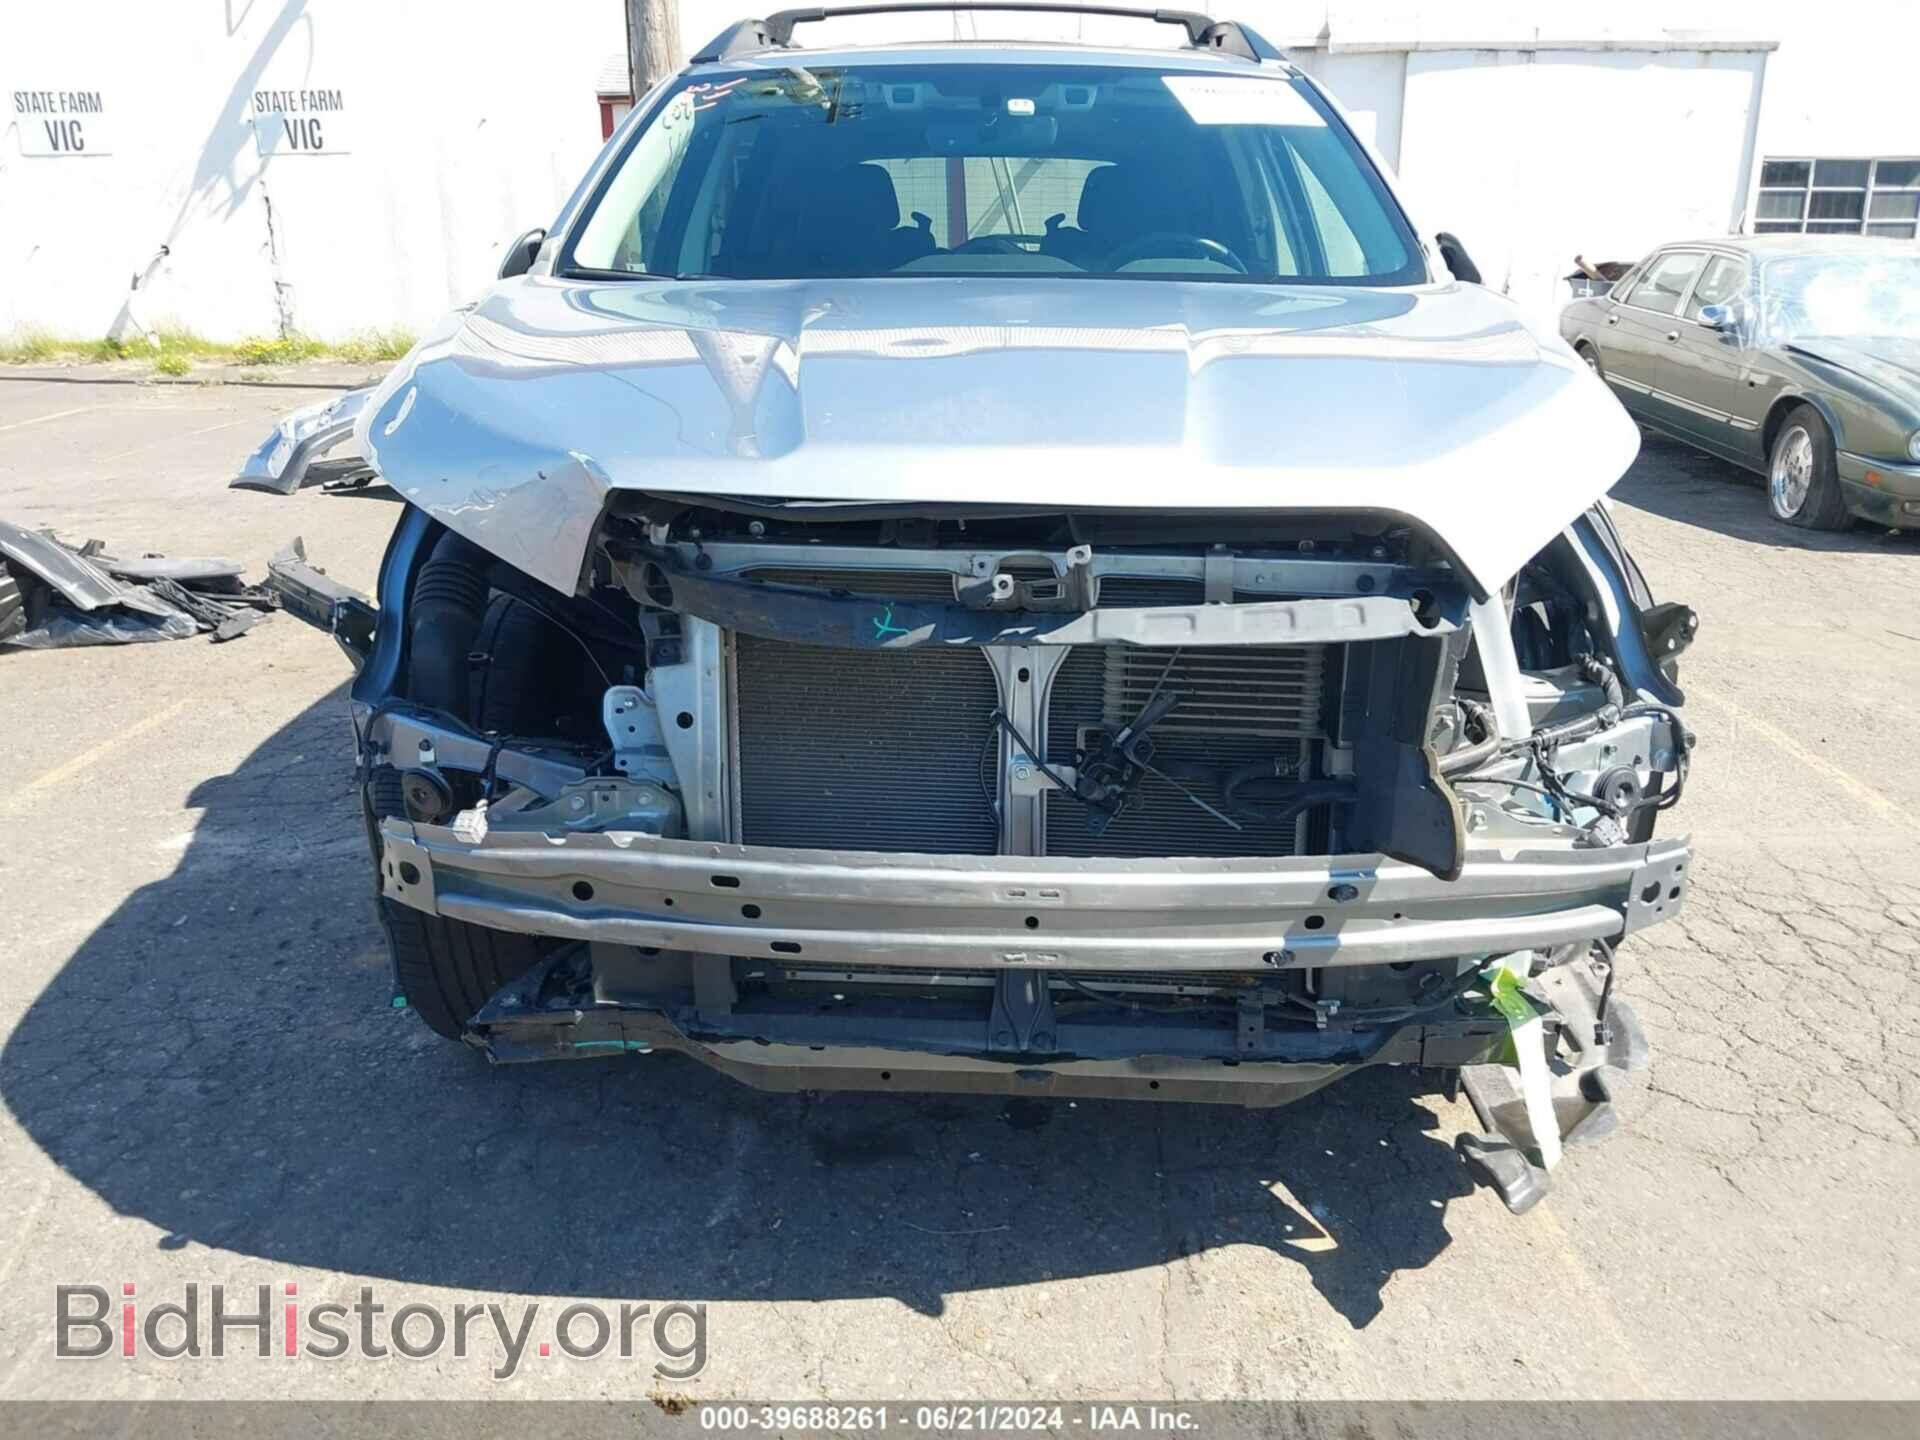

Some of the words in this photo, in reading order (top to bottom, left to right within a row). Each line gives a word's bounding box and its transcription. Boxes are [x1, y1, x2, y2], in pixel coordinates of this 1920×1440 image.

[15, 91, 56, 113] STATE
[60, 91, 103, 112] FARM
[255, 91, 297, 112] STATE
[301, 90, 343, 111] FARM
[45, 120, 84, 151] VIC
[284, 118, 323, 150] VIC
